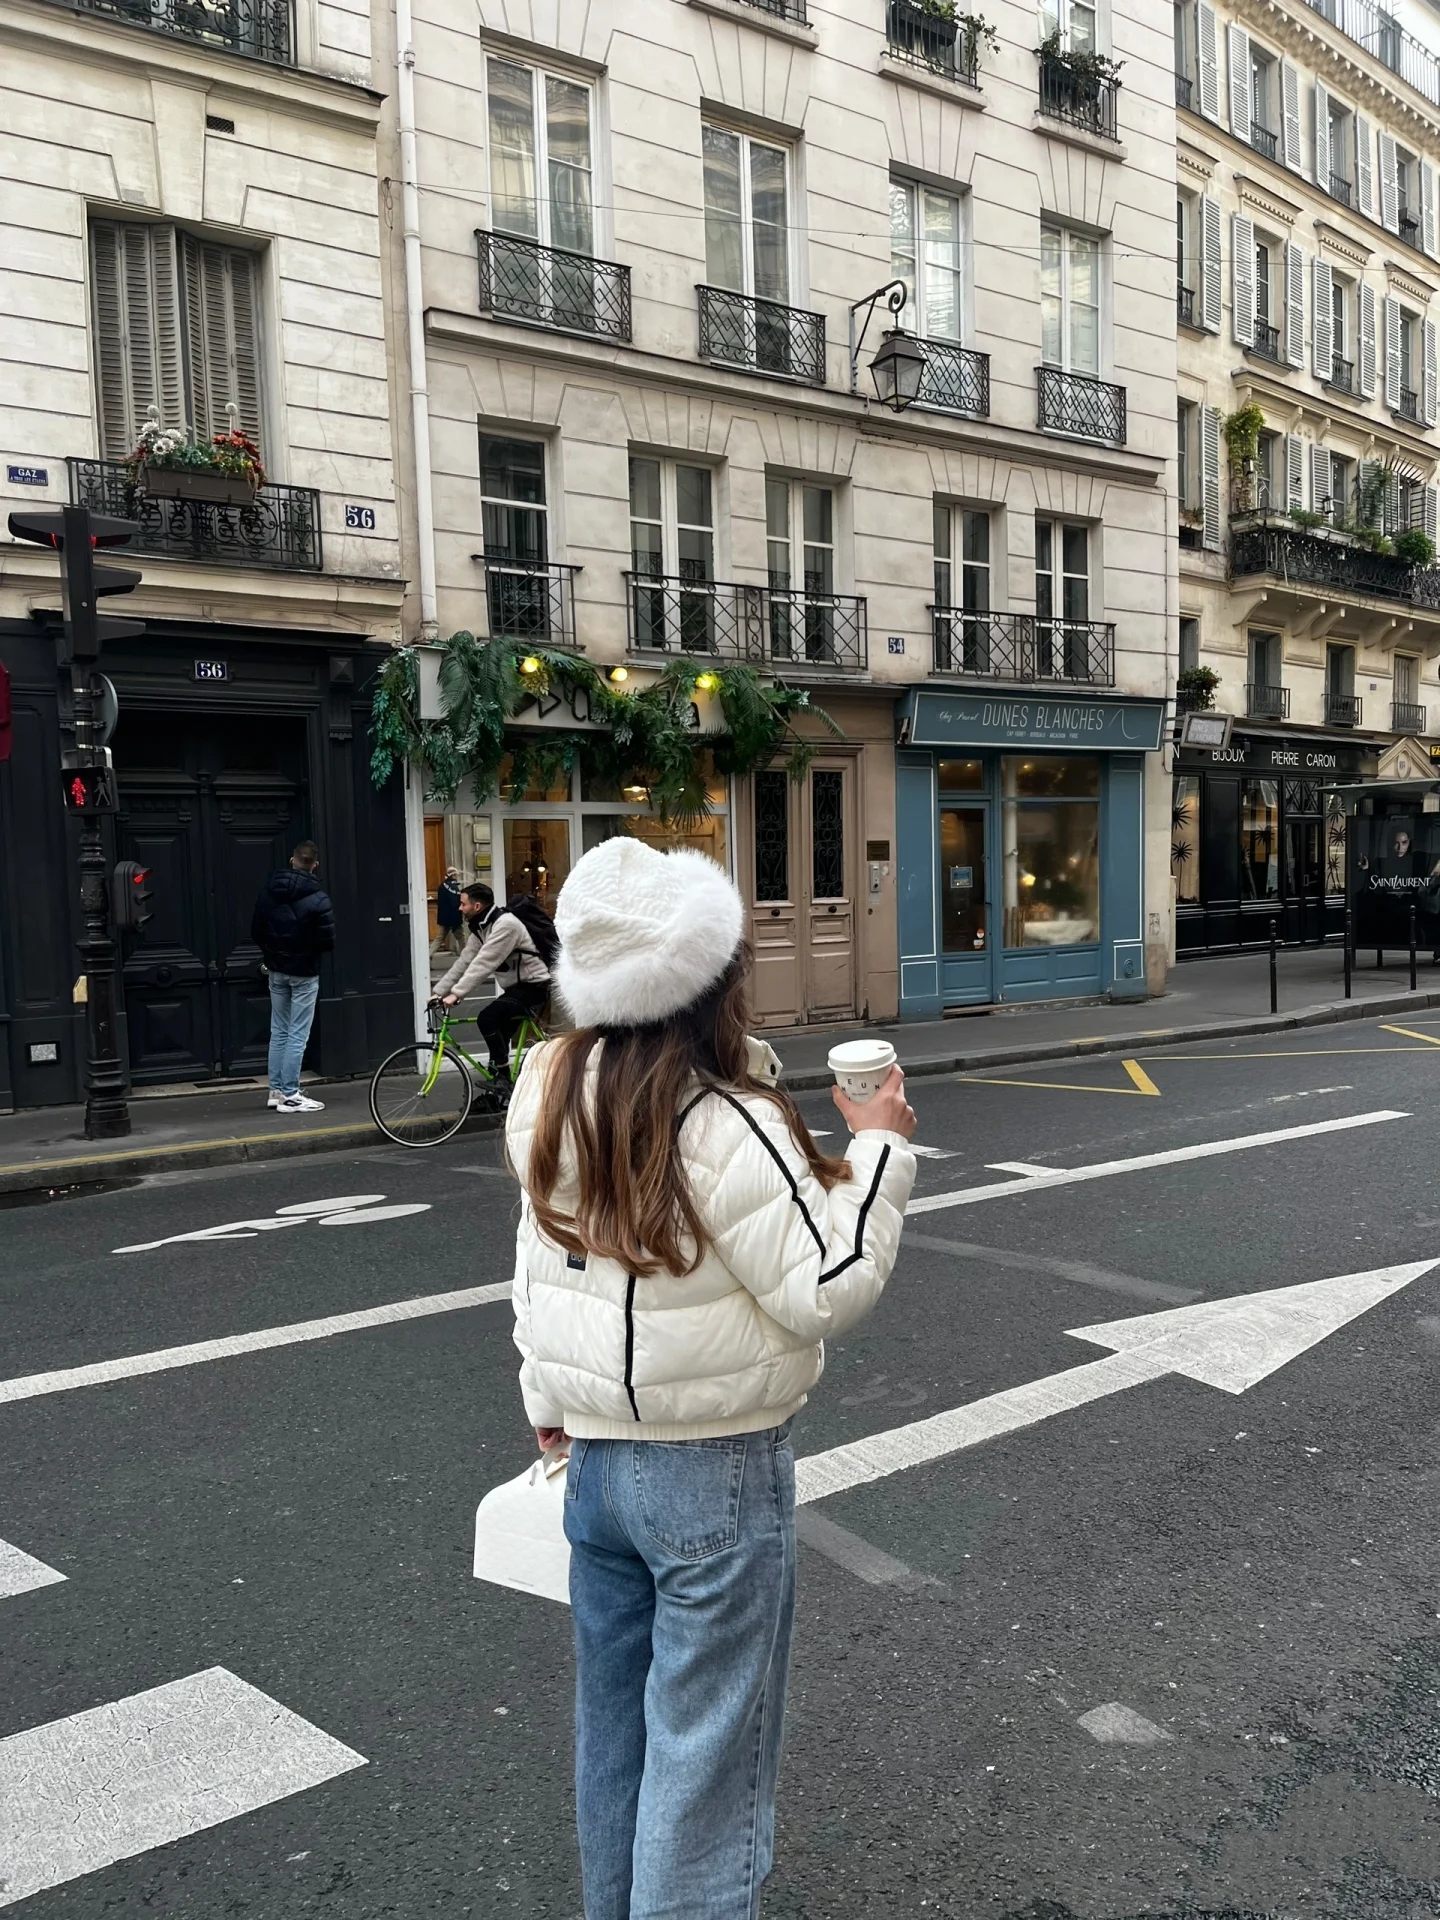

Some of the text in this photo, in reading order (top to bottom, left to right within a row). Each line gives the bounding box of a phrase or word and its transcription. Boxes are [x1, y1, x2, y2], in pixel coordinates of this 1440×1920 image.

[18, 468, 37, 478] GAZ
[347, 506, 372, 527] 56
[889, 638, 904, 653] 54
[200, 663, 223, 678] 56
[982, 703, 1029, 727] DUNES
[1035, 706, 1105, 730] BLANCHES
[1212, 748, 1336, 767] BIJOUX PIERRE CARON
